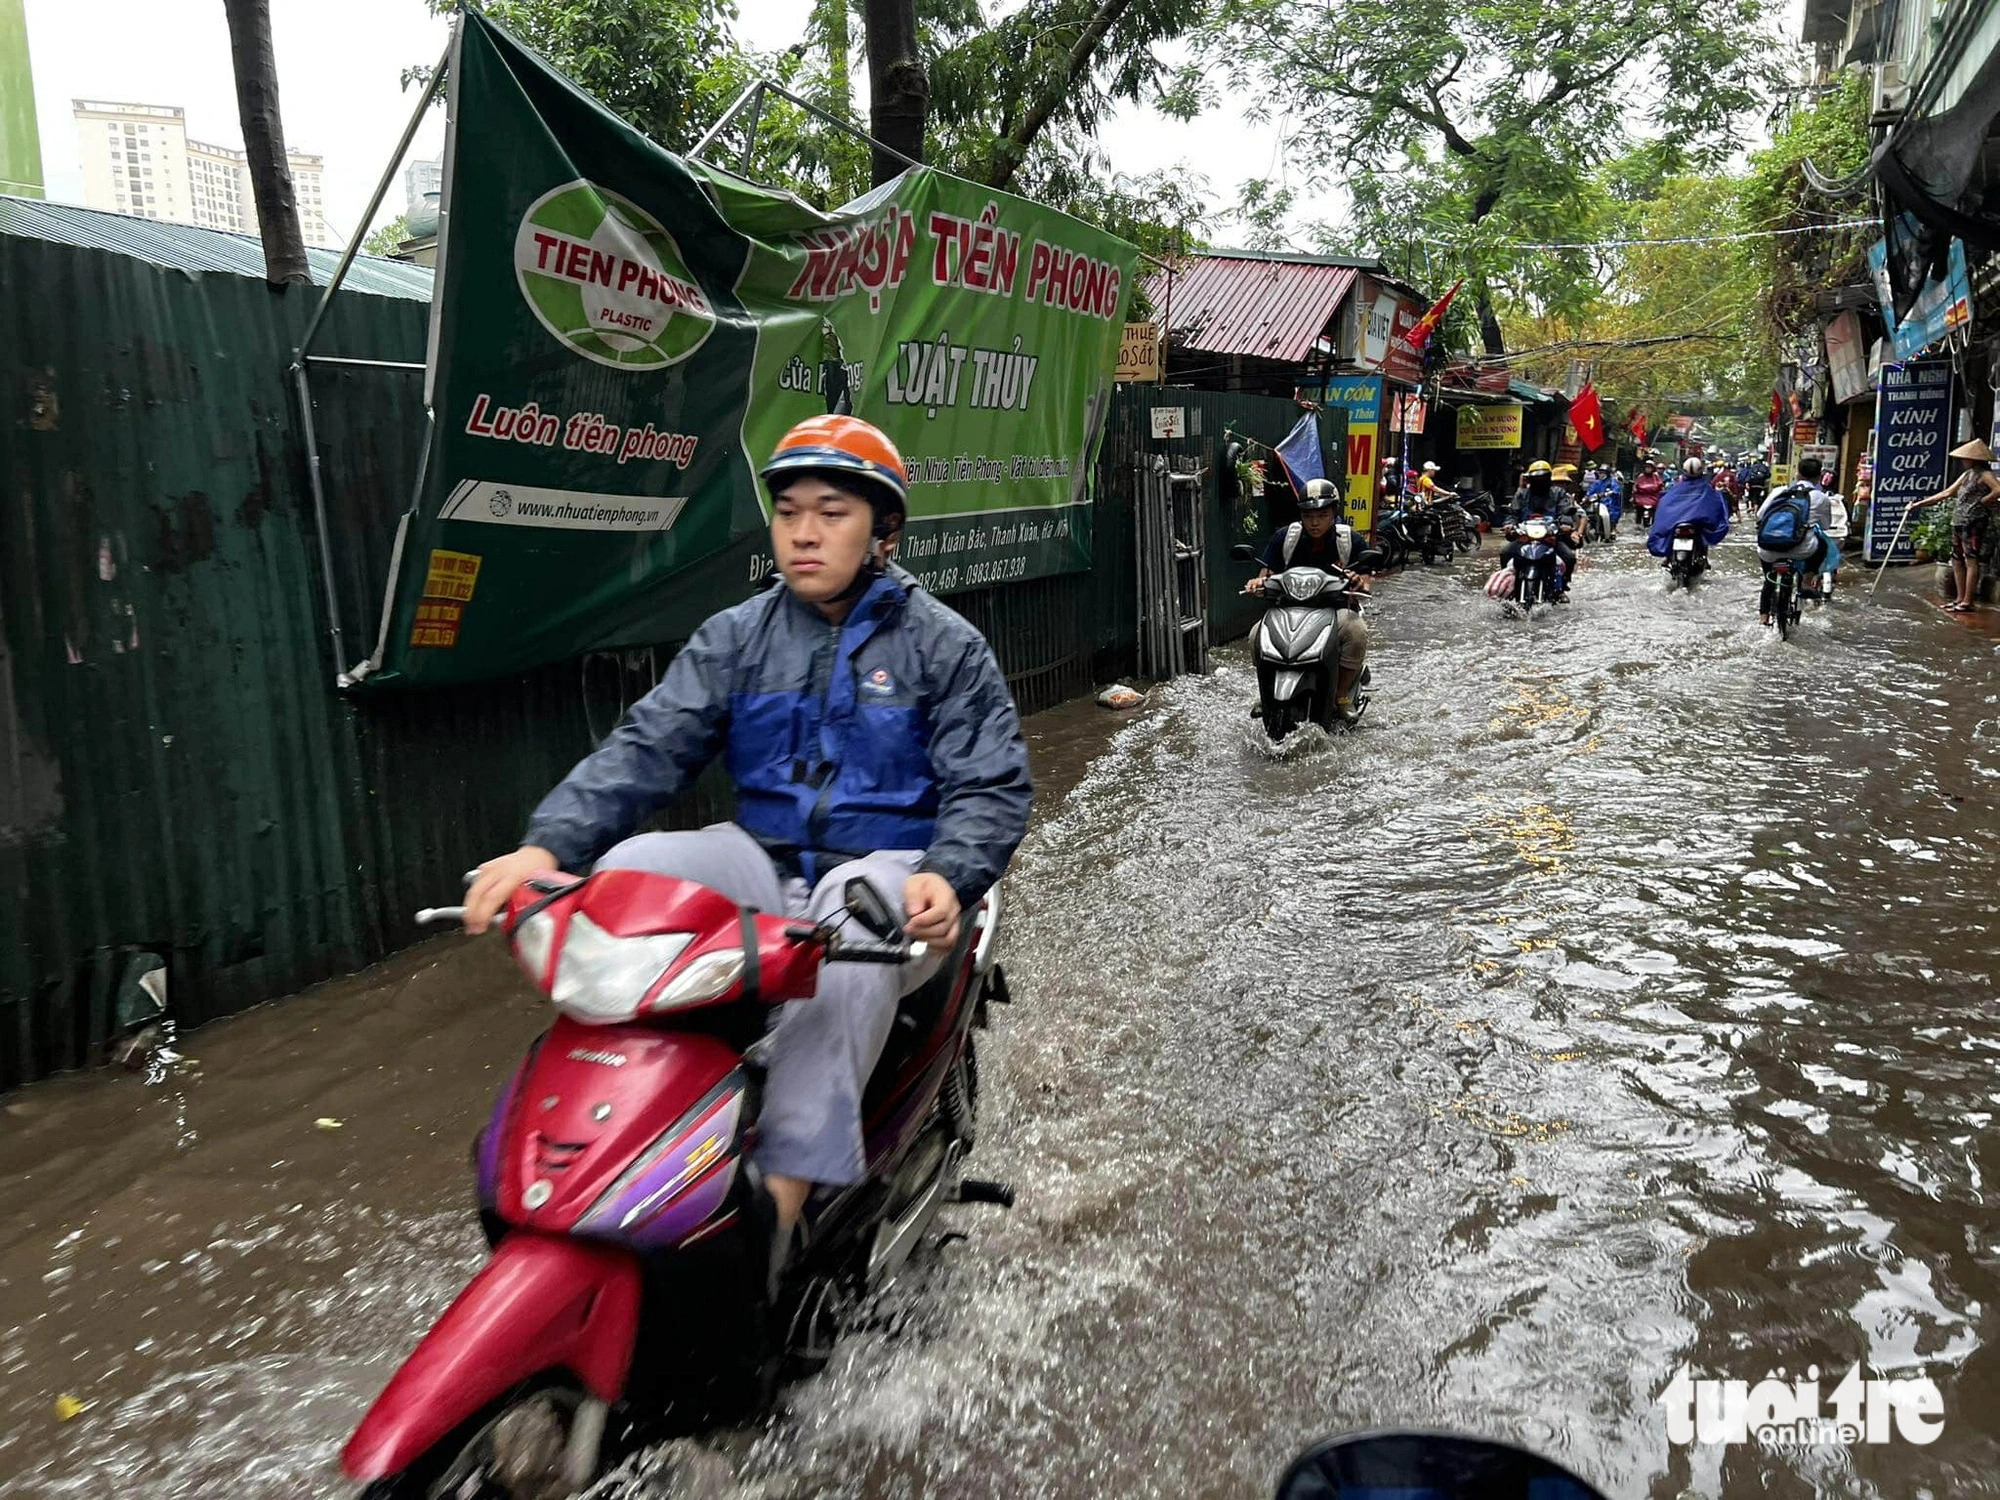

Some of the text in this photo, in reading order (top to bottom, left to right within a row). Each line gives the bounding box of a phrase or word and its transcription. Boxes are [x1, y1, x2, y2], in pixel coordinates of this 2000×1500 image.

[533, 232, 706, 314] TIEN PHONG
[928, 200, 1021, 299] TIỀN
[1025, 237, 1122, 322] PHONG
[599, 307, 653, 333] PLASTIC
[886, 331, 1039, 419] LUẬT THỦY
[466, 393, 560, 446] Luôn
[617, 421, 698, 470] phong
[1890, 406, 1939, 426] KÍNH
[1887, 428, 1938, 448] CHÀO
[923, 456, 949, 488] Nhựa
[952, 452, 973, 483] Tiền
[974, 455, 1002, 485] Phong
[1878, 473, 1942, 492] KHÁCH
[517, 501, 660, 527] www.nhuatienphong.vn
[907, 531, 938, 560] Thanh
[940, 530, 966, 554] Xuân
[967, 525, 988, 551] Bắc,
[990, 521, 1018, 548] Thanh
[1018, 522, 1040, 544] Xuân,
[1041, 520, 1054, 540] Hà
[965, 555, 1027, 586] 0983.867.938
